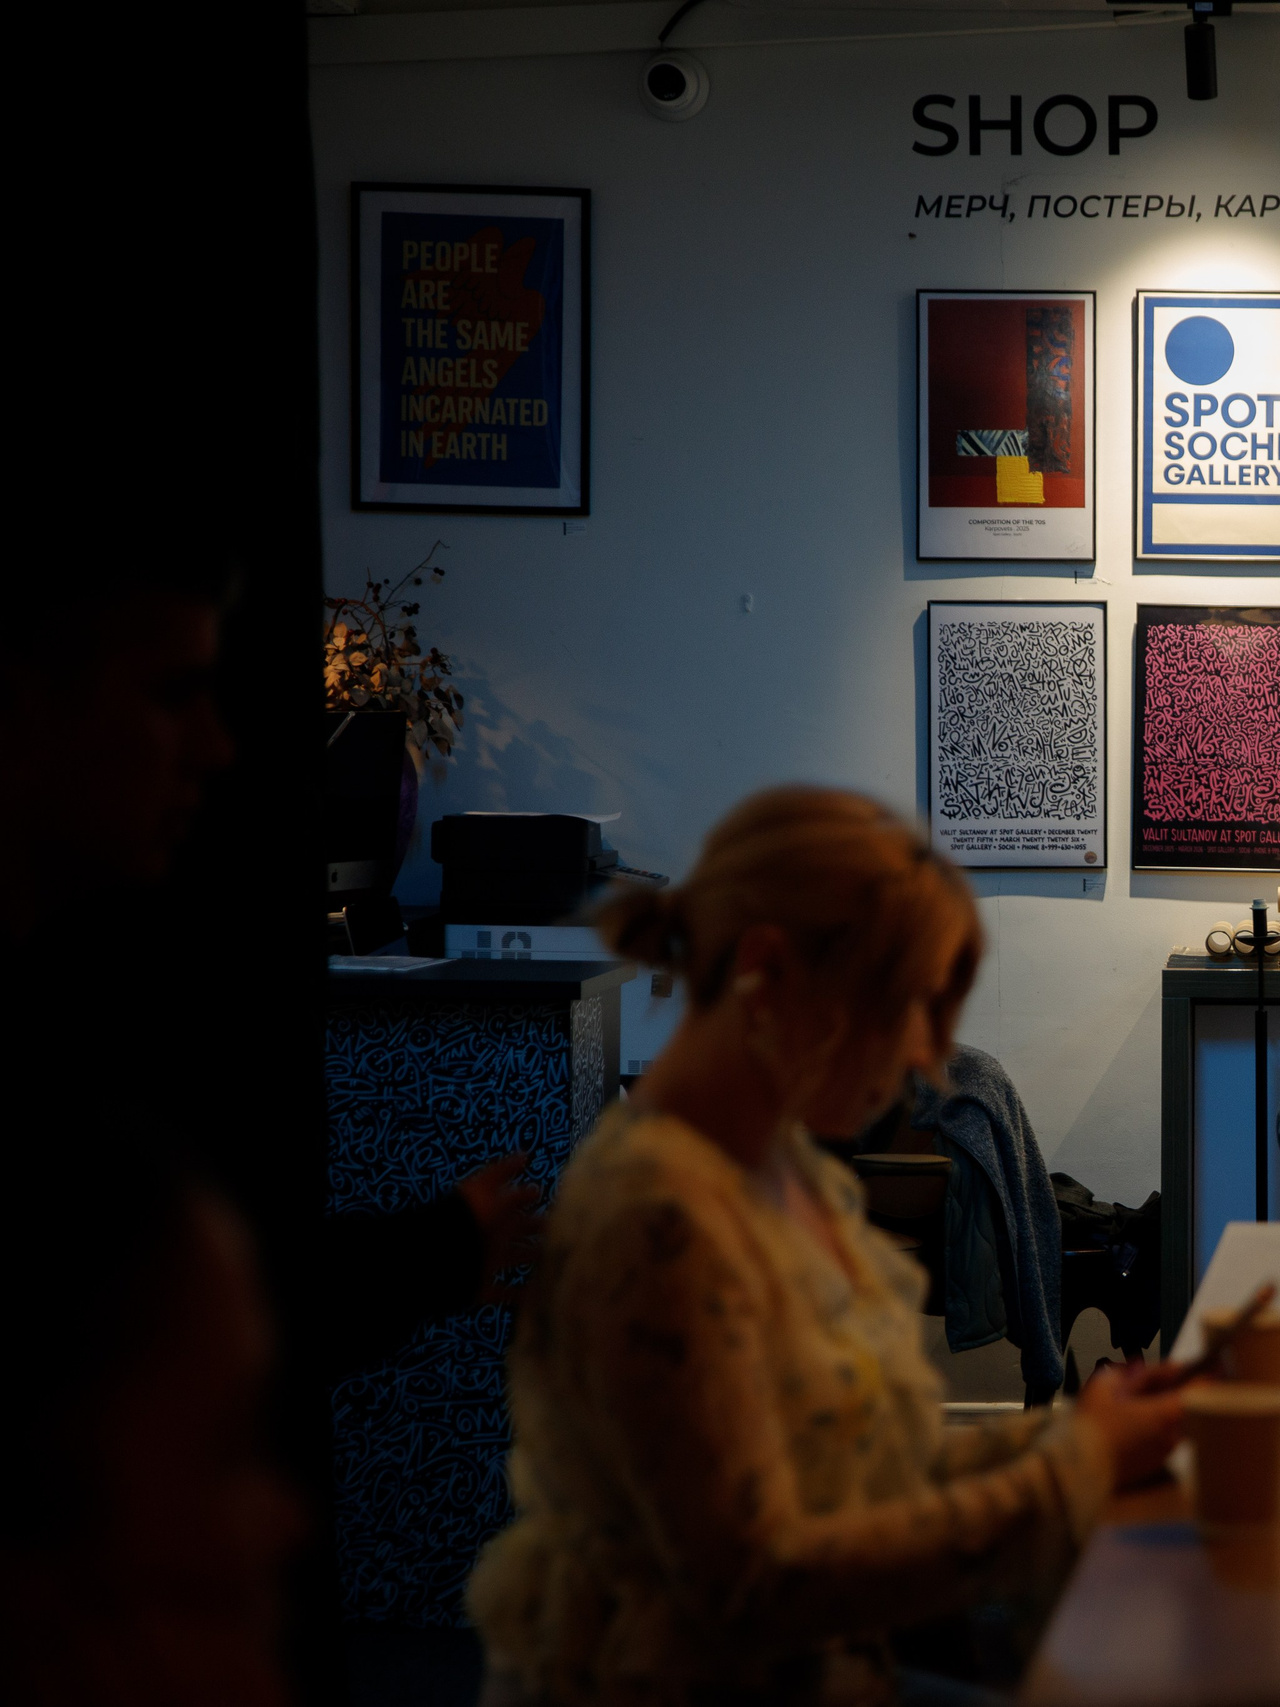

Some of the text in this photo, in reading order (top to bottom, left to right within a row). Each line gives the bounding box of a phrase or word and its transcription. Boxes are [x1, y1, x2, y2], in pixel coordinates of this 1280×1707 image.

[912, 94, 1159, 157] SHOP
[914, 195, 1015, 222] МЕРЧ,
[1027, 194, 1204, 222] ПОСТЕРЫ,
[402, 240, 499, 274] PEOPLE
[401, 279, 450, 310] ARE
[402, 318, 529, 351] THE SAME
[401, 356, 498, 389] ANGELS
[401, 395, 549, 427] INCARNATED
[401, 430, 508, 461] IN EARTH
[1142, 828, 1168, 841] VALIT
[1171, 829, 1218, 842] SULTANOV
[1220, 829, 1232, 843] AT
[1234, 830, 1257, 843] SPOT
